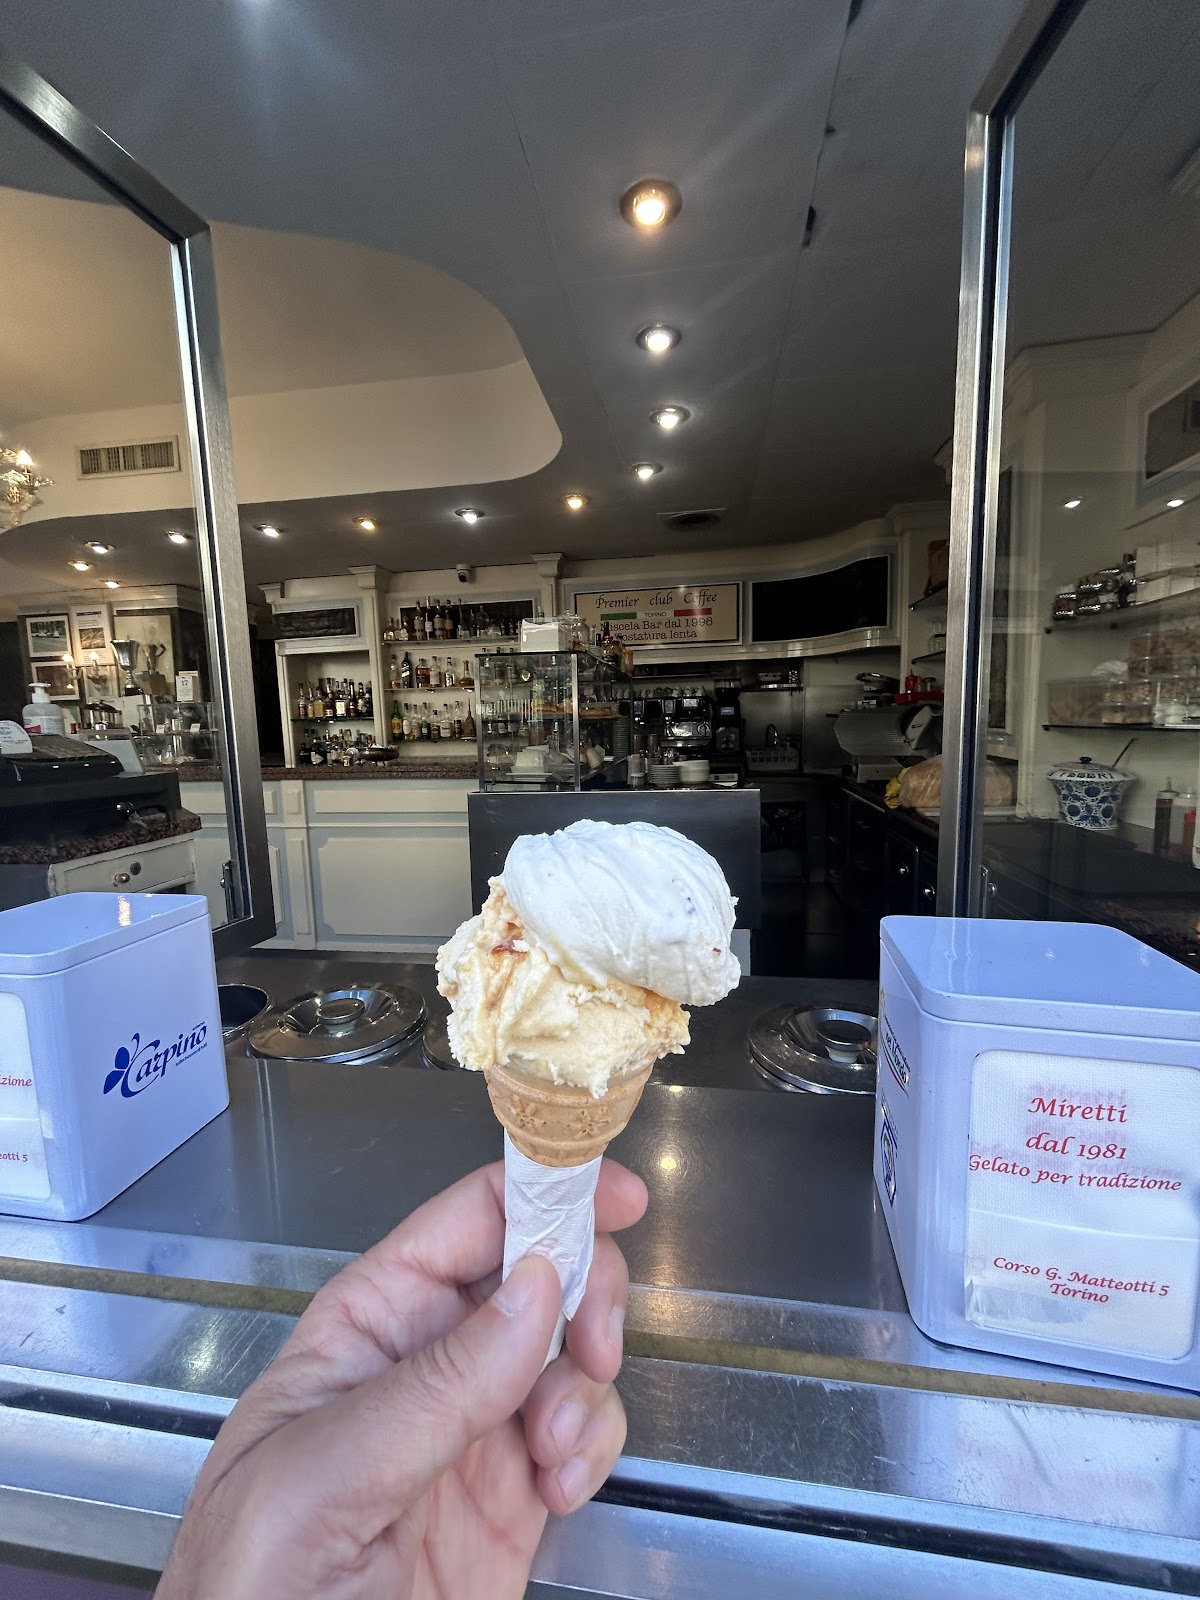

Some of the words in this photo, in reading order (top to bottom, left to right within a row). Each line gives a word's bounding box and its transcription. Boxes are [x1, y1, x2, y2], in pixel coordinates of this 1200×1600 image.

[595, 593, 640, 609] Premier
[649, 591, 673, 606] club
[644, 610, 667, 618] TORINO
[642, 620, 662, 630] Bar
[664, 618, 681, 628] dal
[685, 617, 713, 627] 1996
[670, 629, 698, 639] lenta
[0, 1074, 33, 1087] zione
[1027, 1096, 1129, 1124] Miretti
[1025, 1132, 1076, 1155] dal
[1076, 1143, 1128, 1161] 1981
[22, 1154, 28, 1162] 5
[968, 1154, 1030, 1177] Gelato
[1031, 1170, 1073, 1185] per
[1078, 1172, 1183, 1192] tradizione
[993, 1256, 1041, 1276] Corso
[1045, 1267, 1062, 1281] G.
[1067, 1271, 1156, 1294] Matteotti
[1158, 1284, 1170, 1297] 5
[1050, 1283, 1110, 1304] Torino
